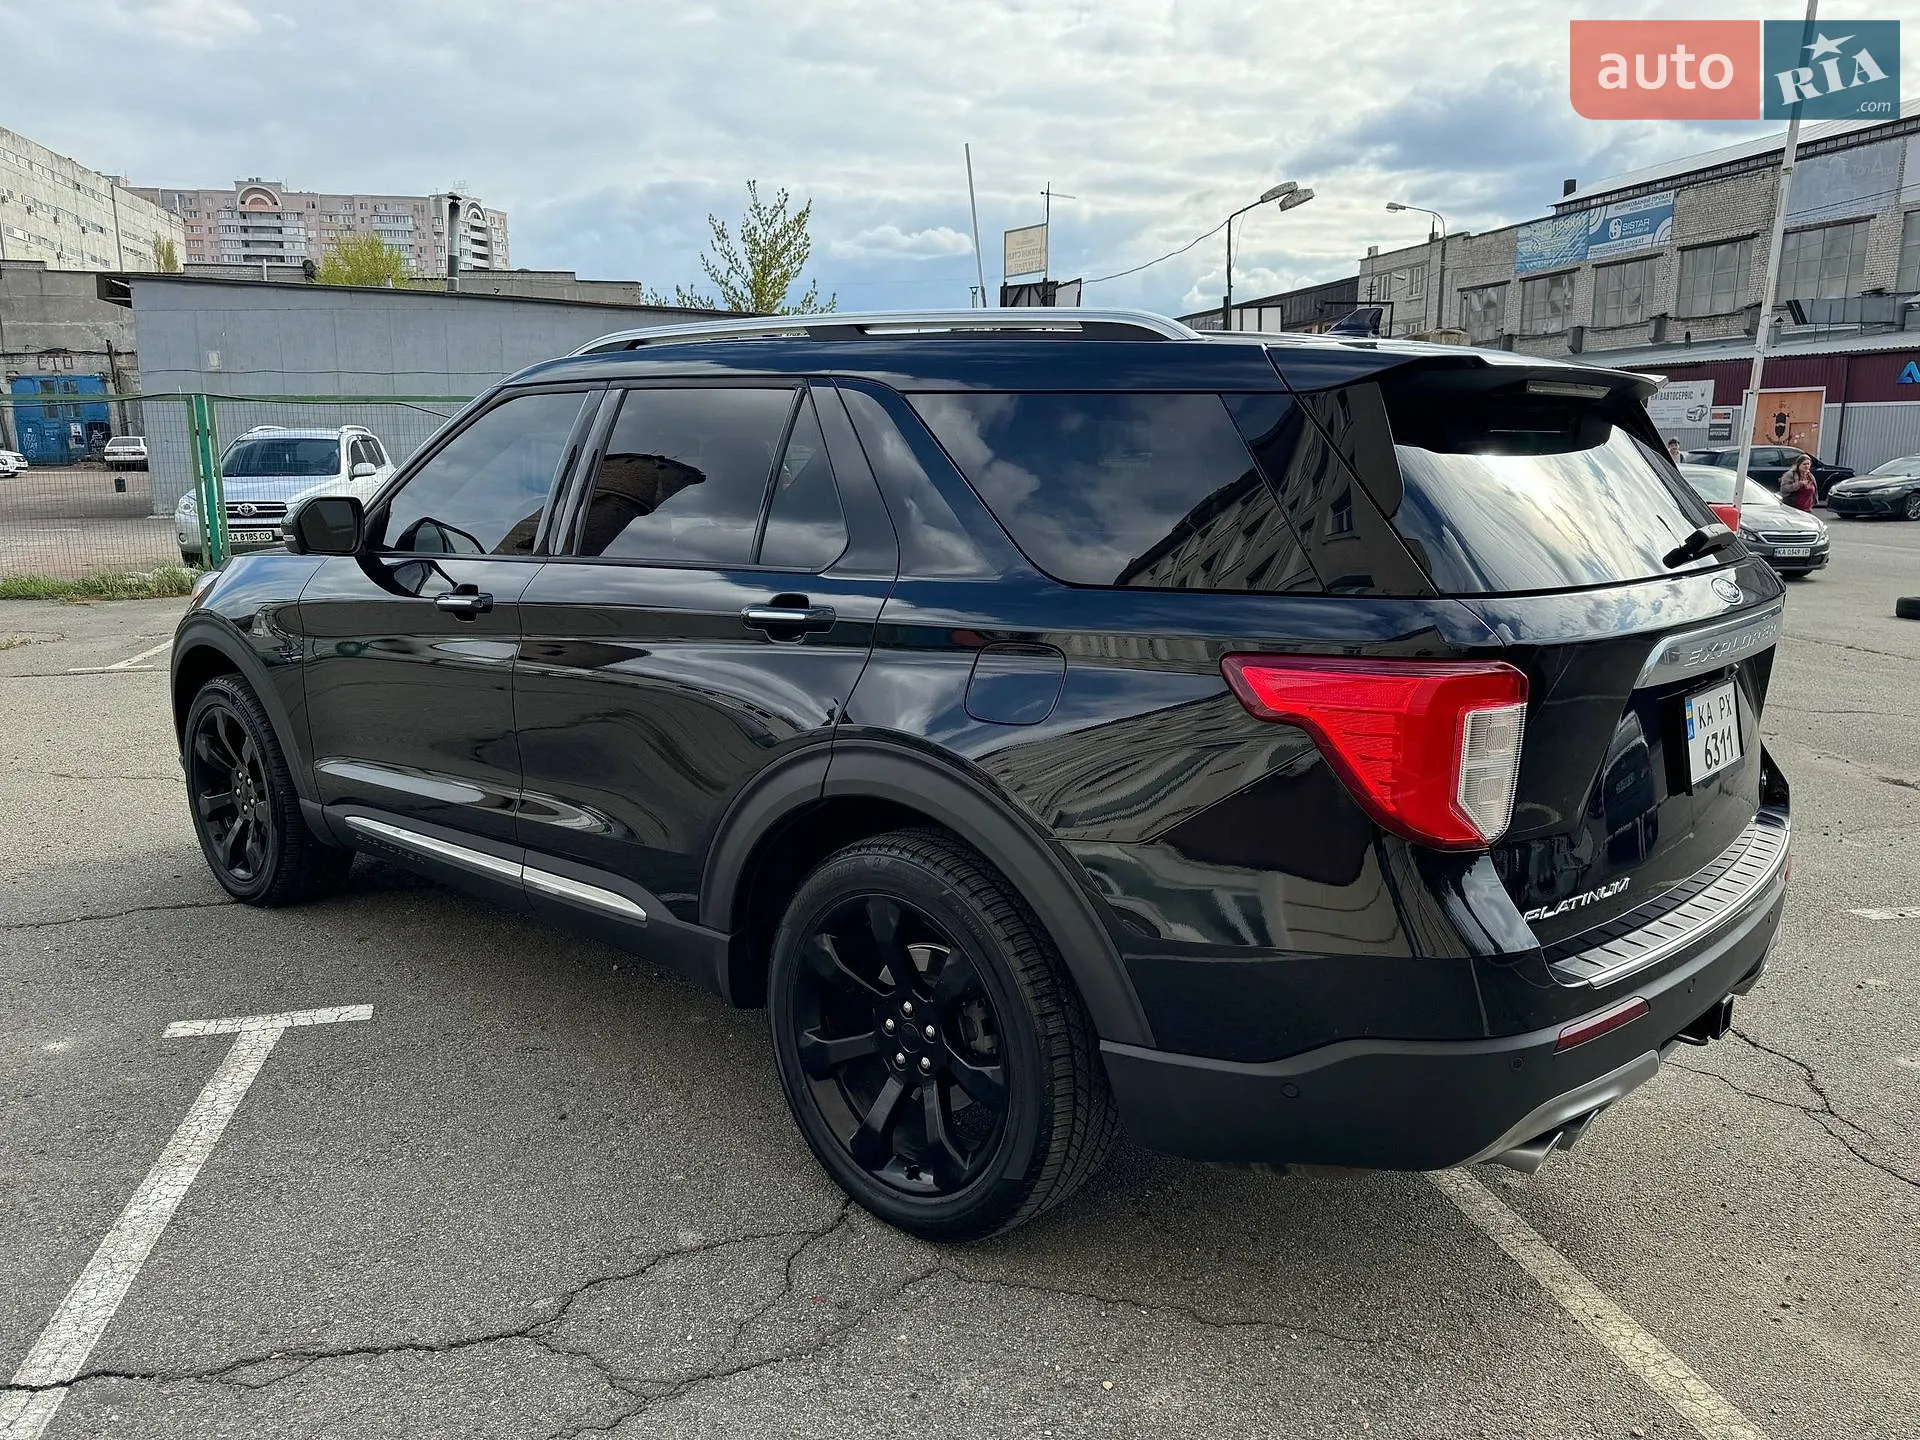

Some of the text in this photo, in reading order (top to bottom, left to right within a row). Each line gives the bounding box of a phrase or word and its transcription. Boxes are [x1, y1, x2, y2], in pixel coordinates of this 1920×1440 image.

[1622, 218, 1650, 231] SISTAR
[259, 532, 271, 540] CO
[1683, 624, 1777, 667] EXPLORER
[1698, 692, 1732, 730] KA PX
[1704, 724, 1734, 770] 6311
[1523, 876, 1632, 922] PLATINUM
